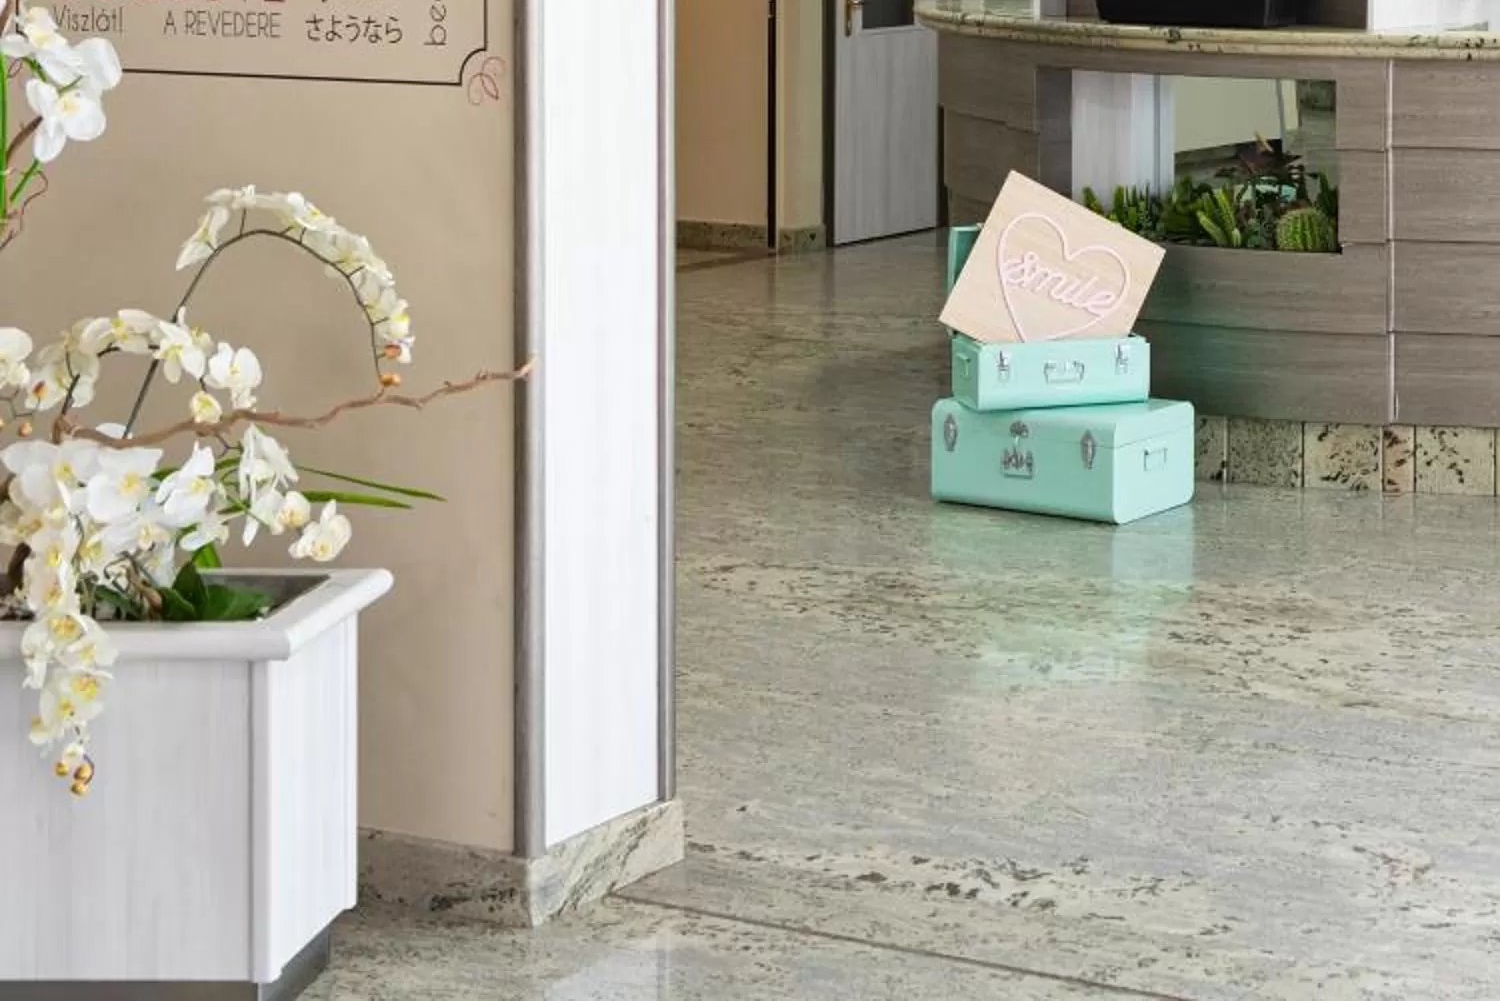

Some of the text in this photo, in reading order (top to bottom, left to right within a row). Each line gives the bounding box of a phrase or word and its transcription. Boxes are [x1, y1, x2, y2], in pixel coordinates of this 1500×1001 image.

[52, 3, 124, 35] Viszlát!
[163, 10, 281, 39] A REVEDERE
[305, 14, 404, 44] さようなら
